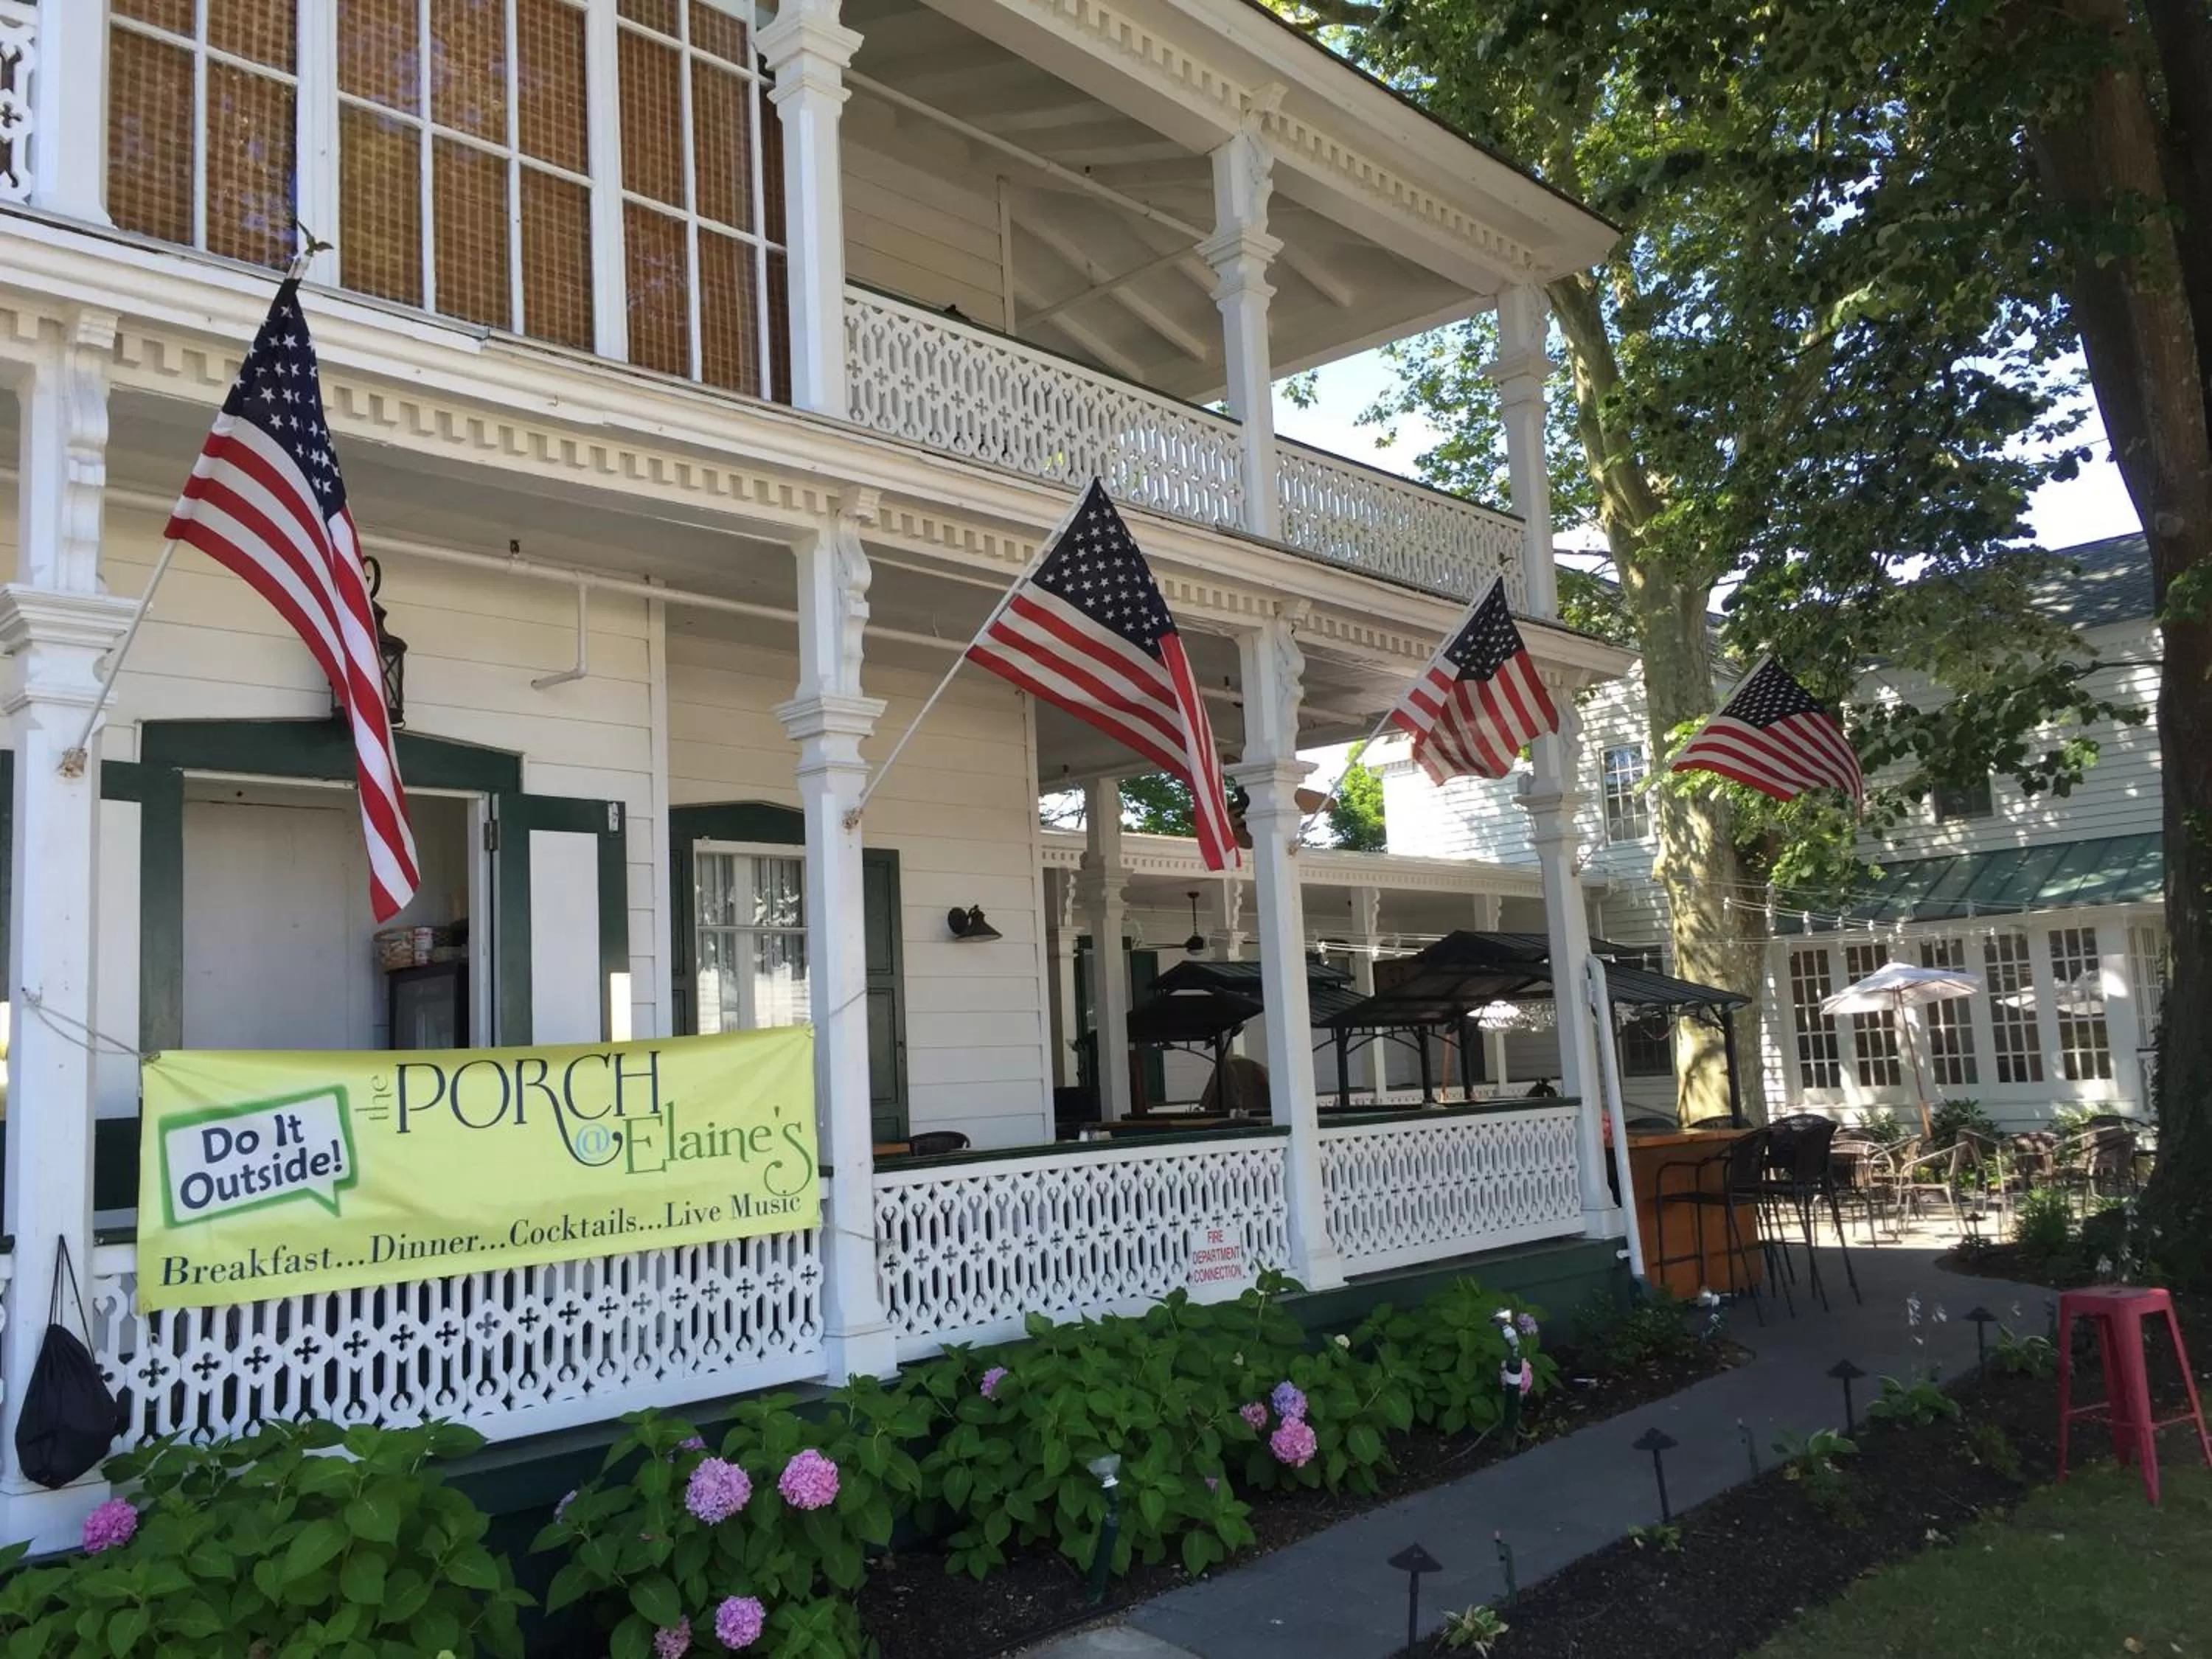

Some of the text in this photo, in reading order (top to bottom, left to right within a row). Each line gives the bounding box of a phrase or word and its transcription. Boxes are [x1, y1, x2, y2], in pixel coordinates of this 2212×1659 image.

[355, 1051, 661, 1166] the PORCH
[201, 1114, 305, 1164] Do It
[622, 1100, 813, 1196] Elaine's
[180, 1139, 343, 1210] Outside!
[729, 1190, 801, 1220] Music
[1192, 1245, 1239, 1265] DEPARTMENT
[1207, 1229, 1224, 1243] FIRE
[1194, 1265, 1242, 1283] CONNECTION
